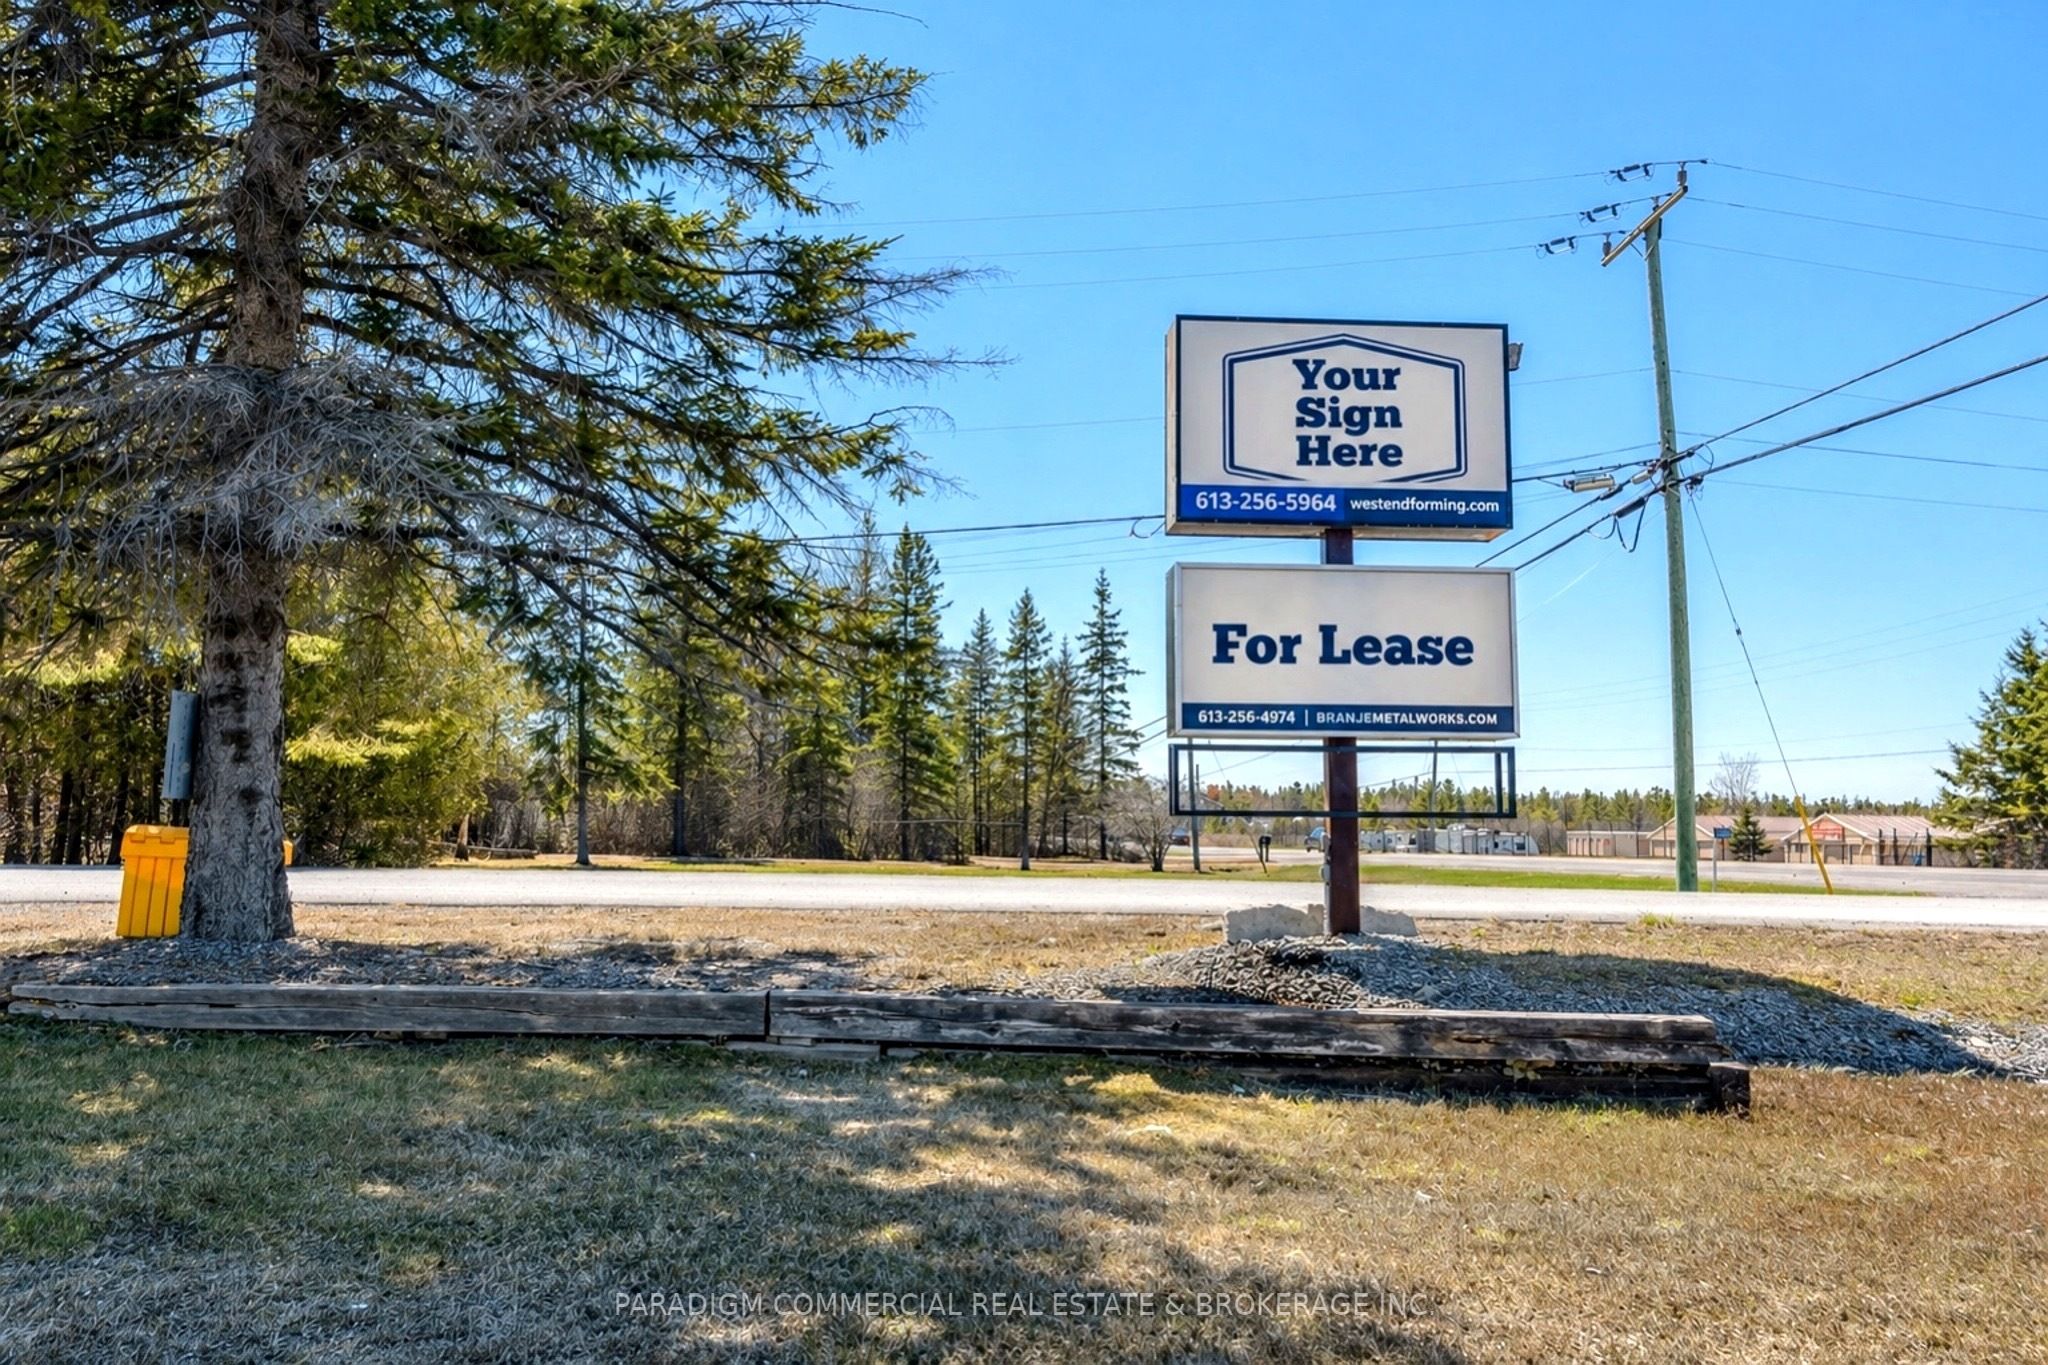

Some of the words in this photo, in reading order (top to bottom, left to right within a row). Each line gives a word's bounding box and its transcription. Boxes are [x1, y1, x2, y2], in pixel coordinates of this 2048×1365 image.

[1292, 358, 1401, 392] Your
[1296, 396, 1402, 436] Sign
[1296, 435, 1403, 467] Here
[1195, 491, 1337, 513] 613-256-5964
[1350, 496, 1499, 515] westendforming.com
[1212, 623, 1302, 665] For
[1319, 624, 1474, 666] Lease
[1198, 709, 1296, 725] 613-256-4974
[1316, 711, 1498, 726] BRANJEMETALWORKS.COM
